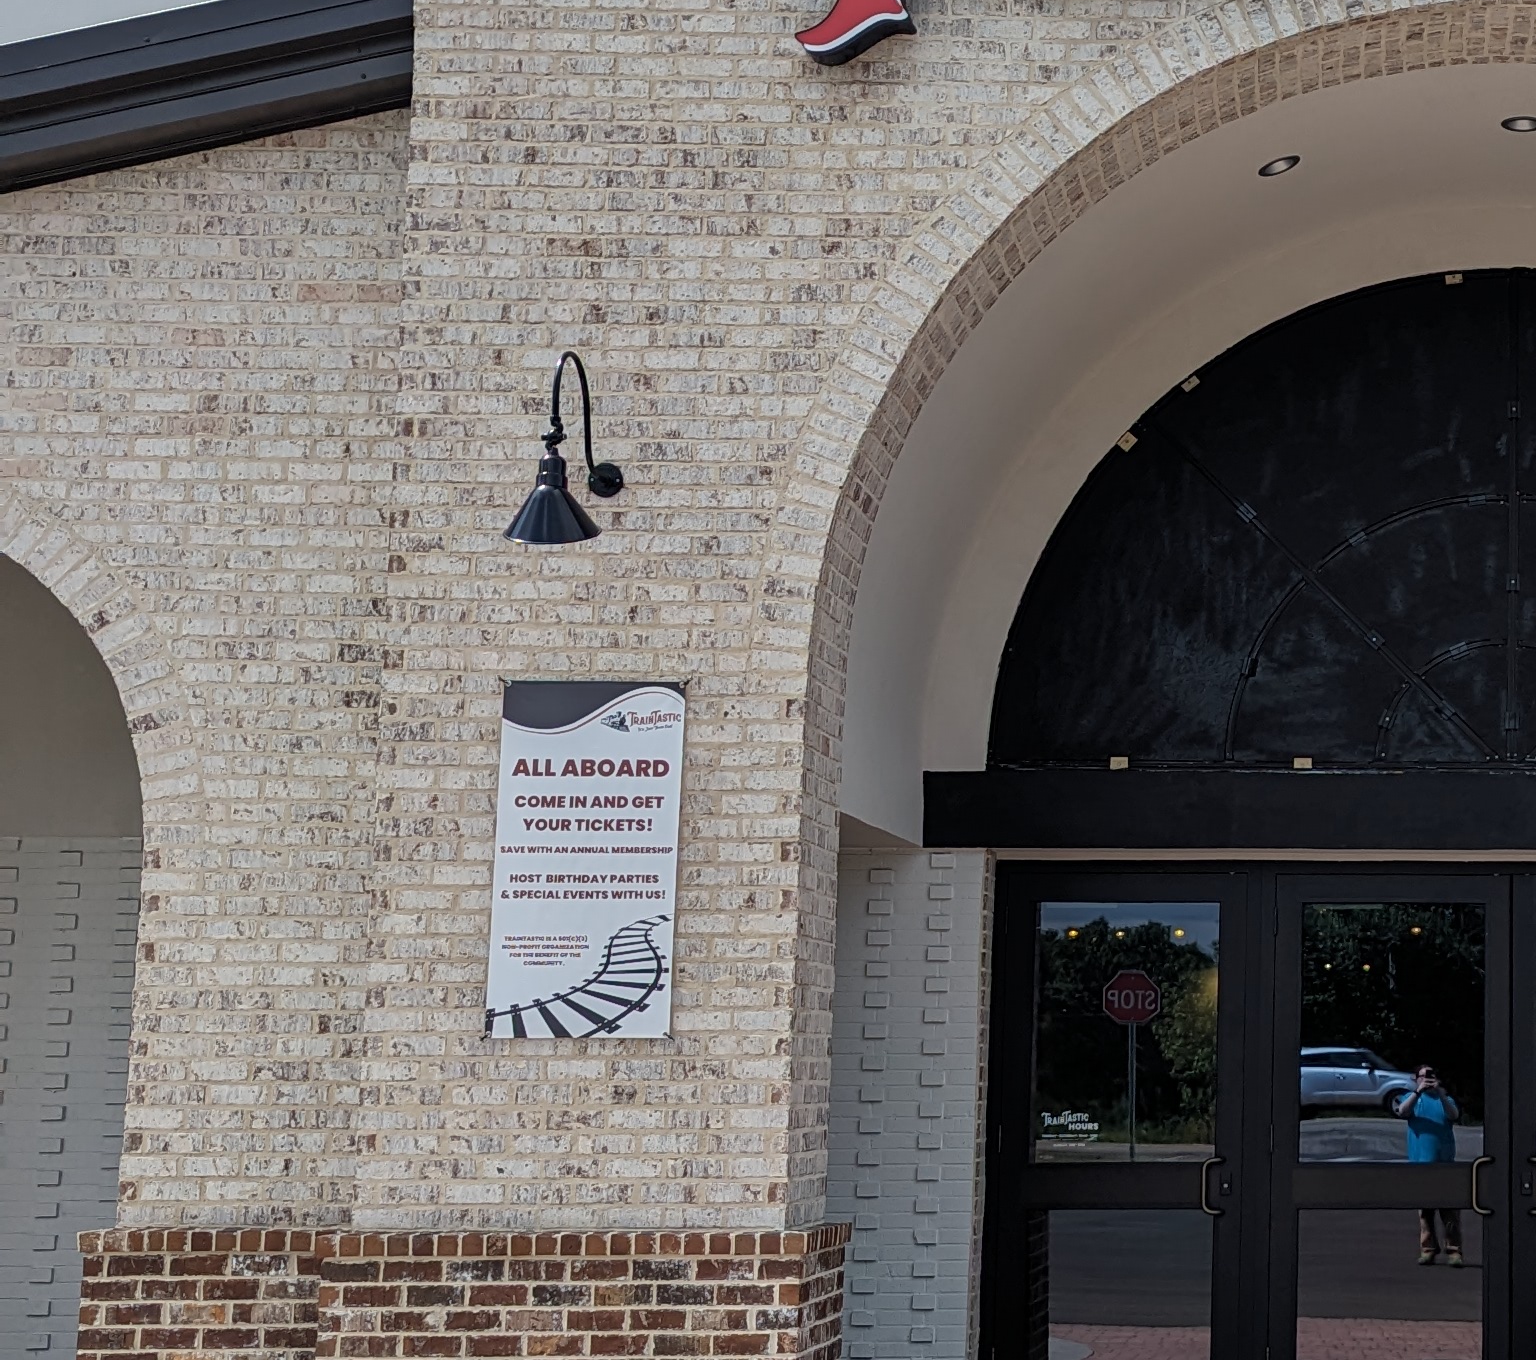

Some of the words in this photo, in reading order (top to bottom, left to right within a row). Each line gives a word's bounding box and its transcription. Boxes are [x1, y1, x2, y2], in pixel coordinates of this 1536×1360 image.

[511, 758, 556, 777] ALL
[560, 759, 670, 777] ABOARD
[514, 795, 567, 809] COME
[569, 796, 587, 808] IN
[590, 796, 629, 809] AND
[631, 796, 665, 809] GET
[522, 818, 572, 831] YOUR
[574, 818, 653, 832] TICKETS!
[500, 845, 525, 854] SAVE
[527, 846, 553, 854] WITH
[554, 846, 569, 854] AN
[570, 846, 610, 854] ANNUAL
[611, 846, 674, 855] MEMBERSHIP
[509, 873, 542, 884] HOST
[545, 874, 608, 884] BIRTHDAY
[609, 874, 660, 884] PARTIES
[500, 891, 510, 900] &
[512, 890, 562, 900] SPECIAL
[563, 891, 609, 900] EVENTS
[611, 891, 644, 900] WITH
[645, 891, 666, 900] US!
[1068, 1122, 1099, 1130] HOURS
